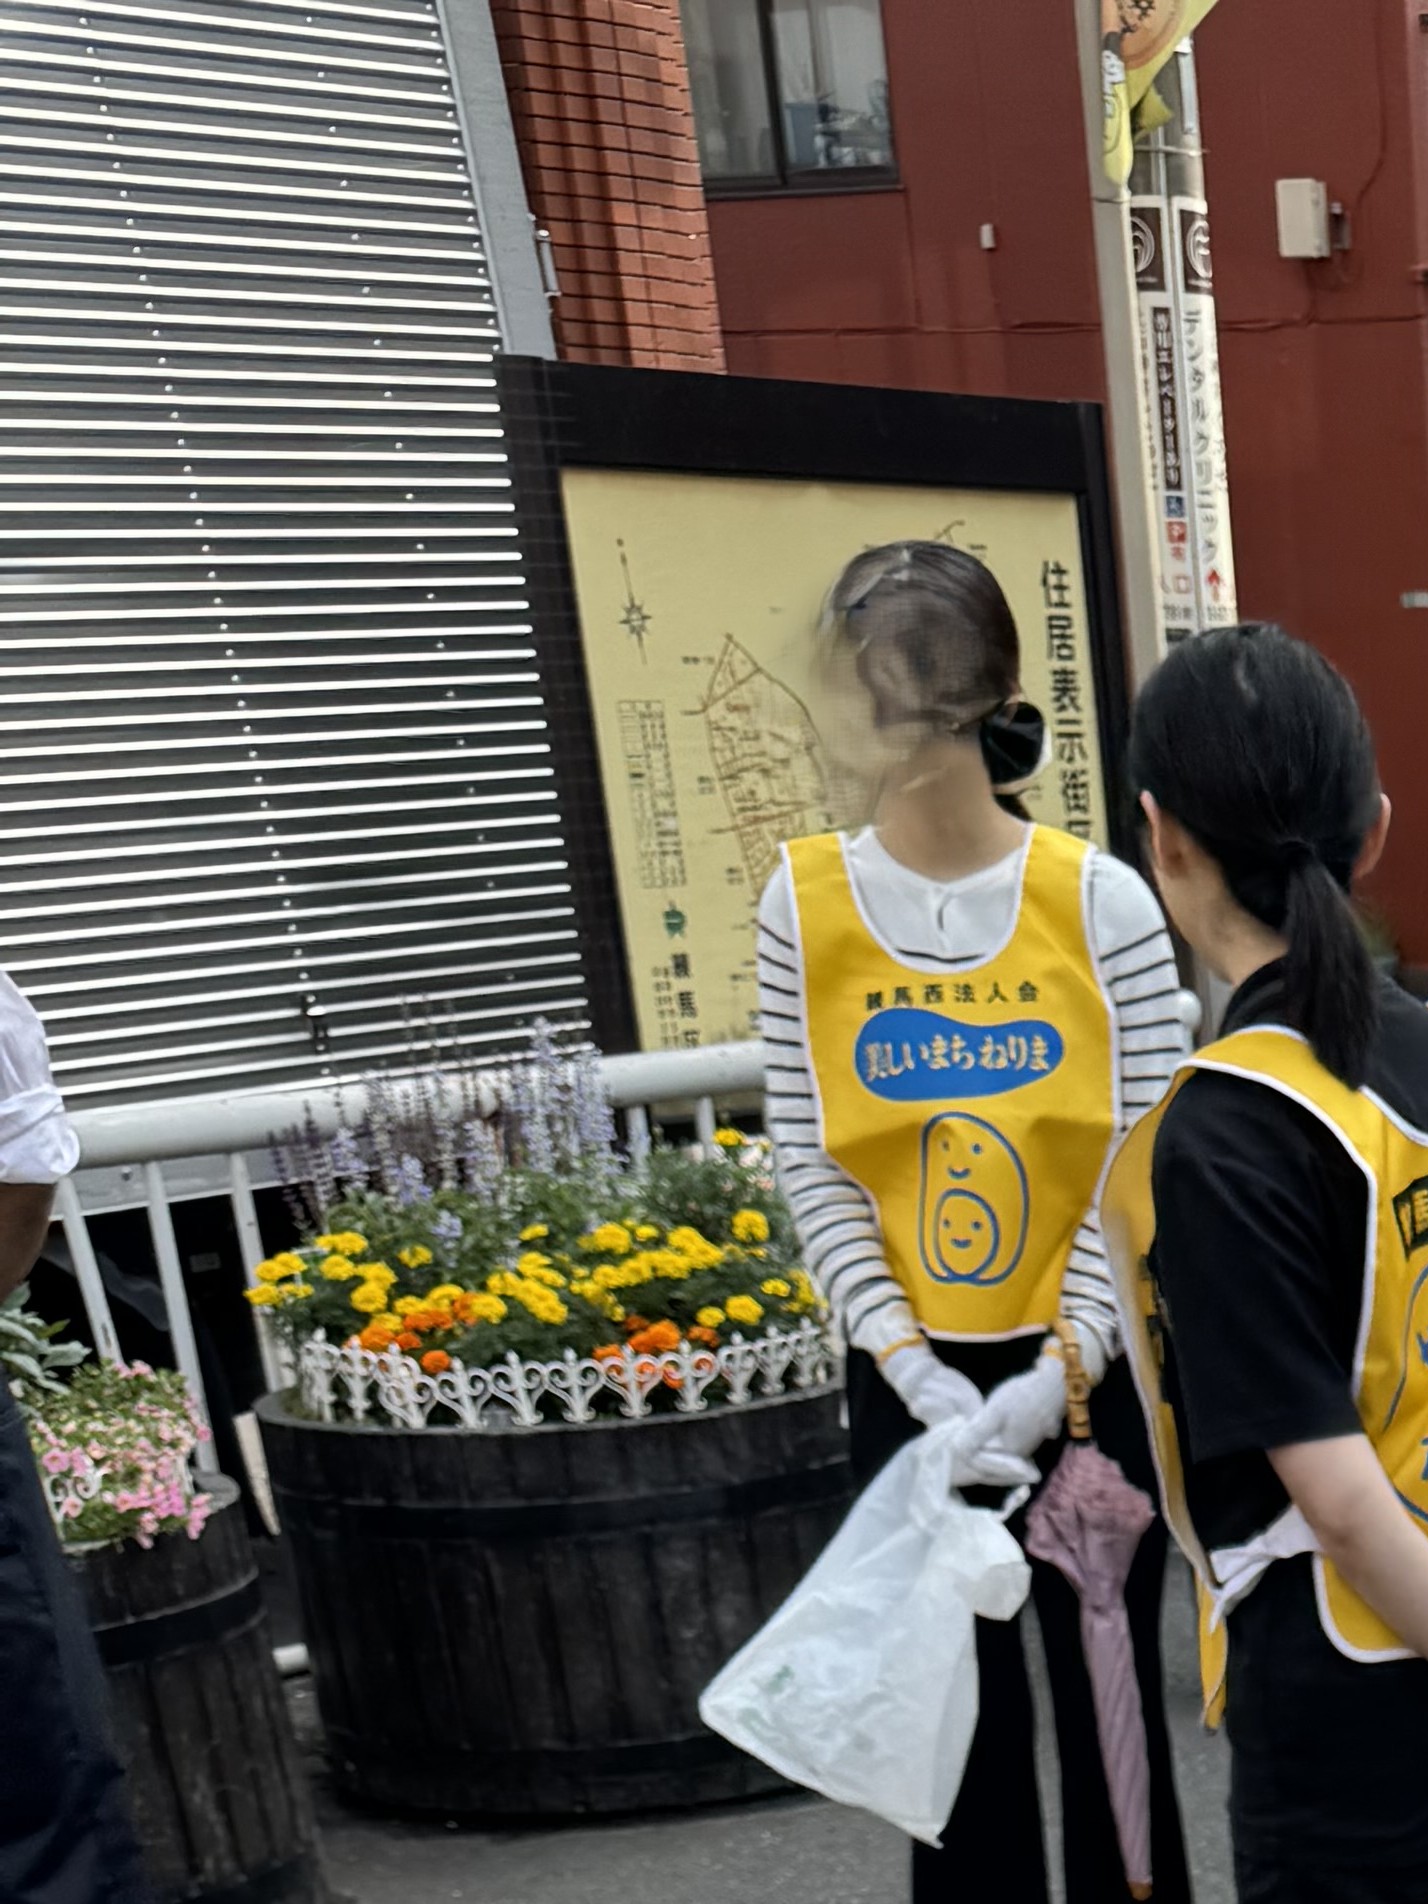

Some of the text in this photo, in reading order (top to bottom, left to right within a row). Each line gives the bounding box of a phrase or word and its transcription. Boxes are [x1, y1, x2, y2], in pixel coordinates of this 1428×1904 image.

[1182, 311, 1219, 565] デンタルクリニック
